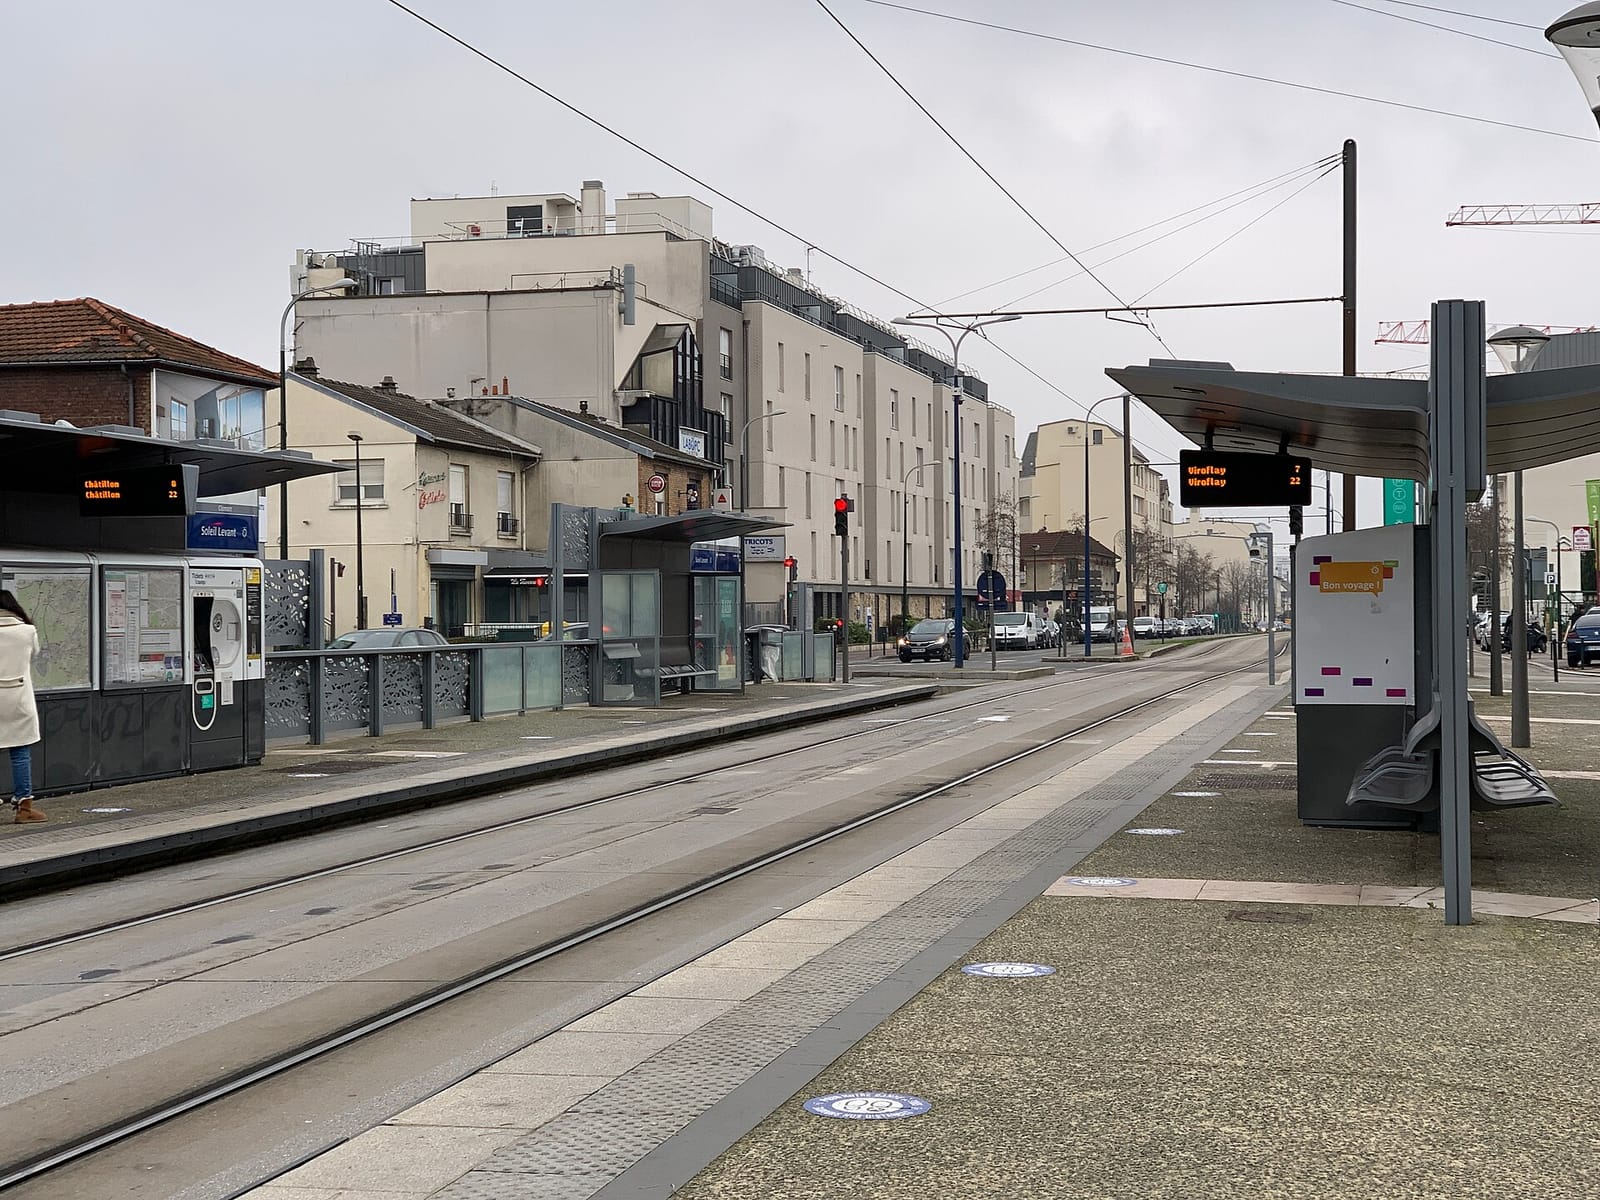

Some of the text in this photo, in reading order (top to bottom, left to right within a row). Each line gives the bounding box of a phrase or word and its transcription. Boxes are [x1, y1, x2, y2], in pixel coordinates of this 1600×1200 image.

[1188, 465, 1226, 476] Viroflay
[1294, 465, 1301, 473] 7
[84, 480, 120, 488] Châtillon
[1188, 477, 1227, 487] Viroflay
[1289, 477, 1301, 485] 22
[85, 491, 121, 499] Châtillon
[168, 491, 178, 499] 22
[201, 525, 237, 537] Soleil Levant
[1322, 581, 1341, 589] Bon
[1343, 582, 1375, 591] voyage
